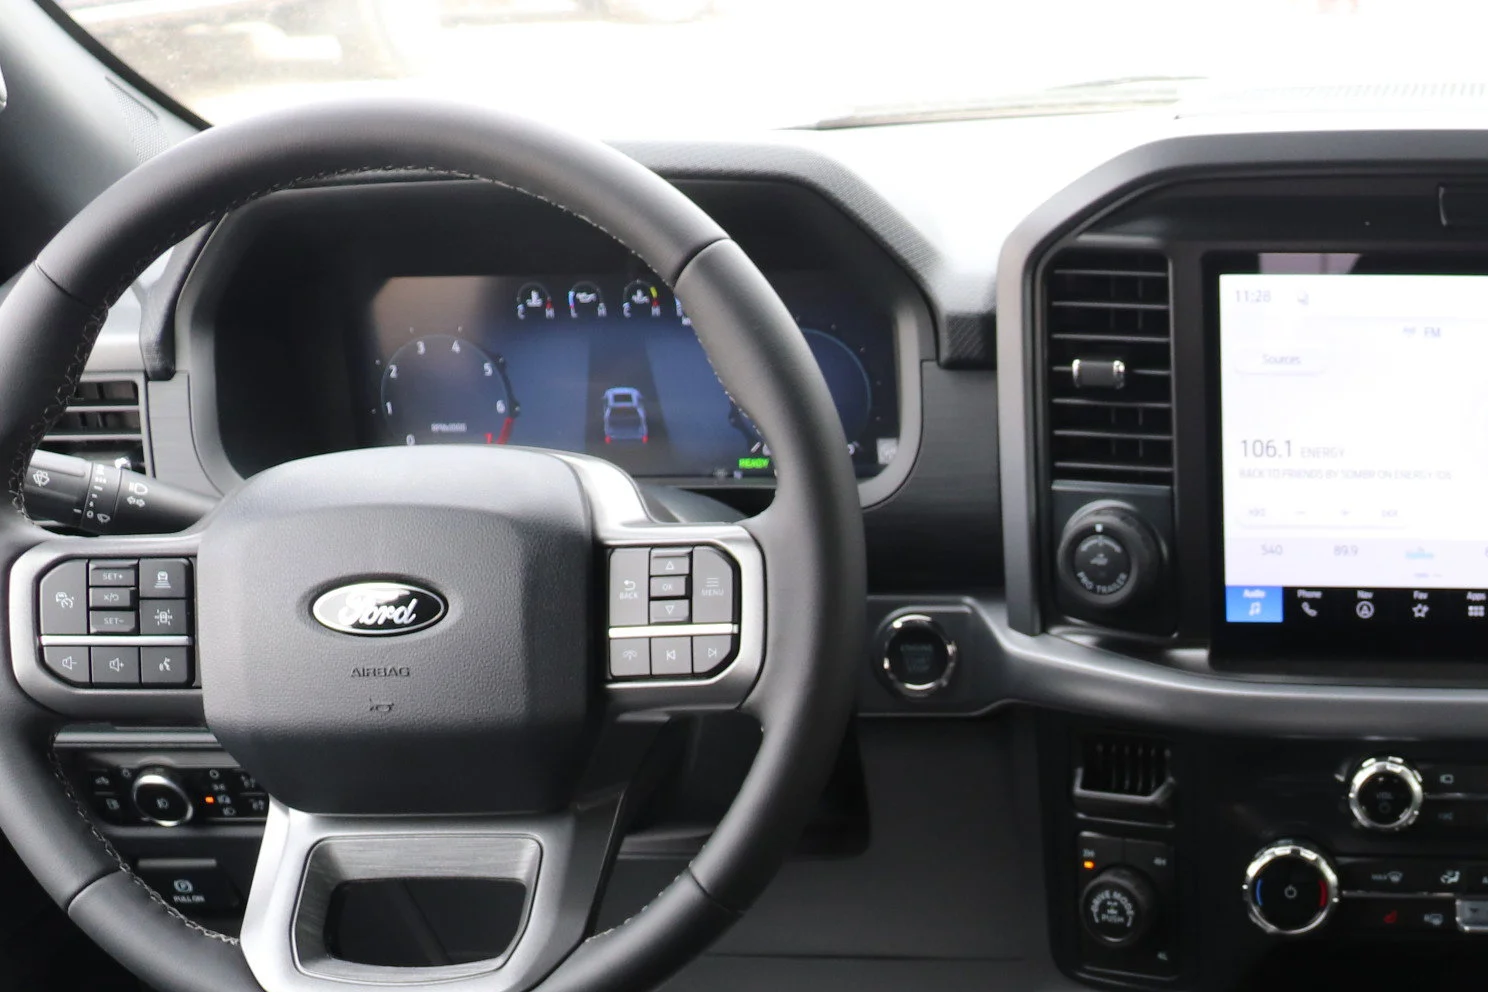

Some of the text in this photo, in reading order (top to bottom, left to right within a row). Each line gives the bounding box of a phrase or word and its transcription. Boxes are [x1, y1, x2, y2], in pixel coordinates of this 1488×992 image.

[1423, 326, 1442, 338] FM
[416, 340, 426, 356] 3
[451, 339, 461, 354] 4
[1261, 353, 1302, 365] Sources
[389, 363, 399, 379] 2
[483, 362, 494, 377] 5
[386, 400, 393, 416] 1
[495, 399, 506, 415] 6
[1240, 439, 1345, 459] 106.1 ENERGY
[1239, 468, 1265, 479] BACK
[1268, 468, 1280, 479] TO
[1281, 468, 1324, 480] FRIENDS
[1325, 468, 1339, 480] BY
[1333, 544, 1359, 557] 89.9
[662, 583, 673, 591] OK
[700, 588, 724, 597] MENU
[1242, 589, 1266, 599] Audio
[1297, 589, 1323, 600] Phone
[1356, 590, 1374, 600] Nav
[1412, 590, 1429, 600] Fav
[1466, 591, 1488, 602] Apps
[337, 587, 418, 626] Ford
[350, 666, 411, 678] AIRBAG
[172, 894, 192, 903] PULL
[1101, 913, 1125, 924] PUSH
